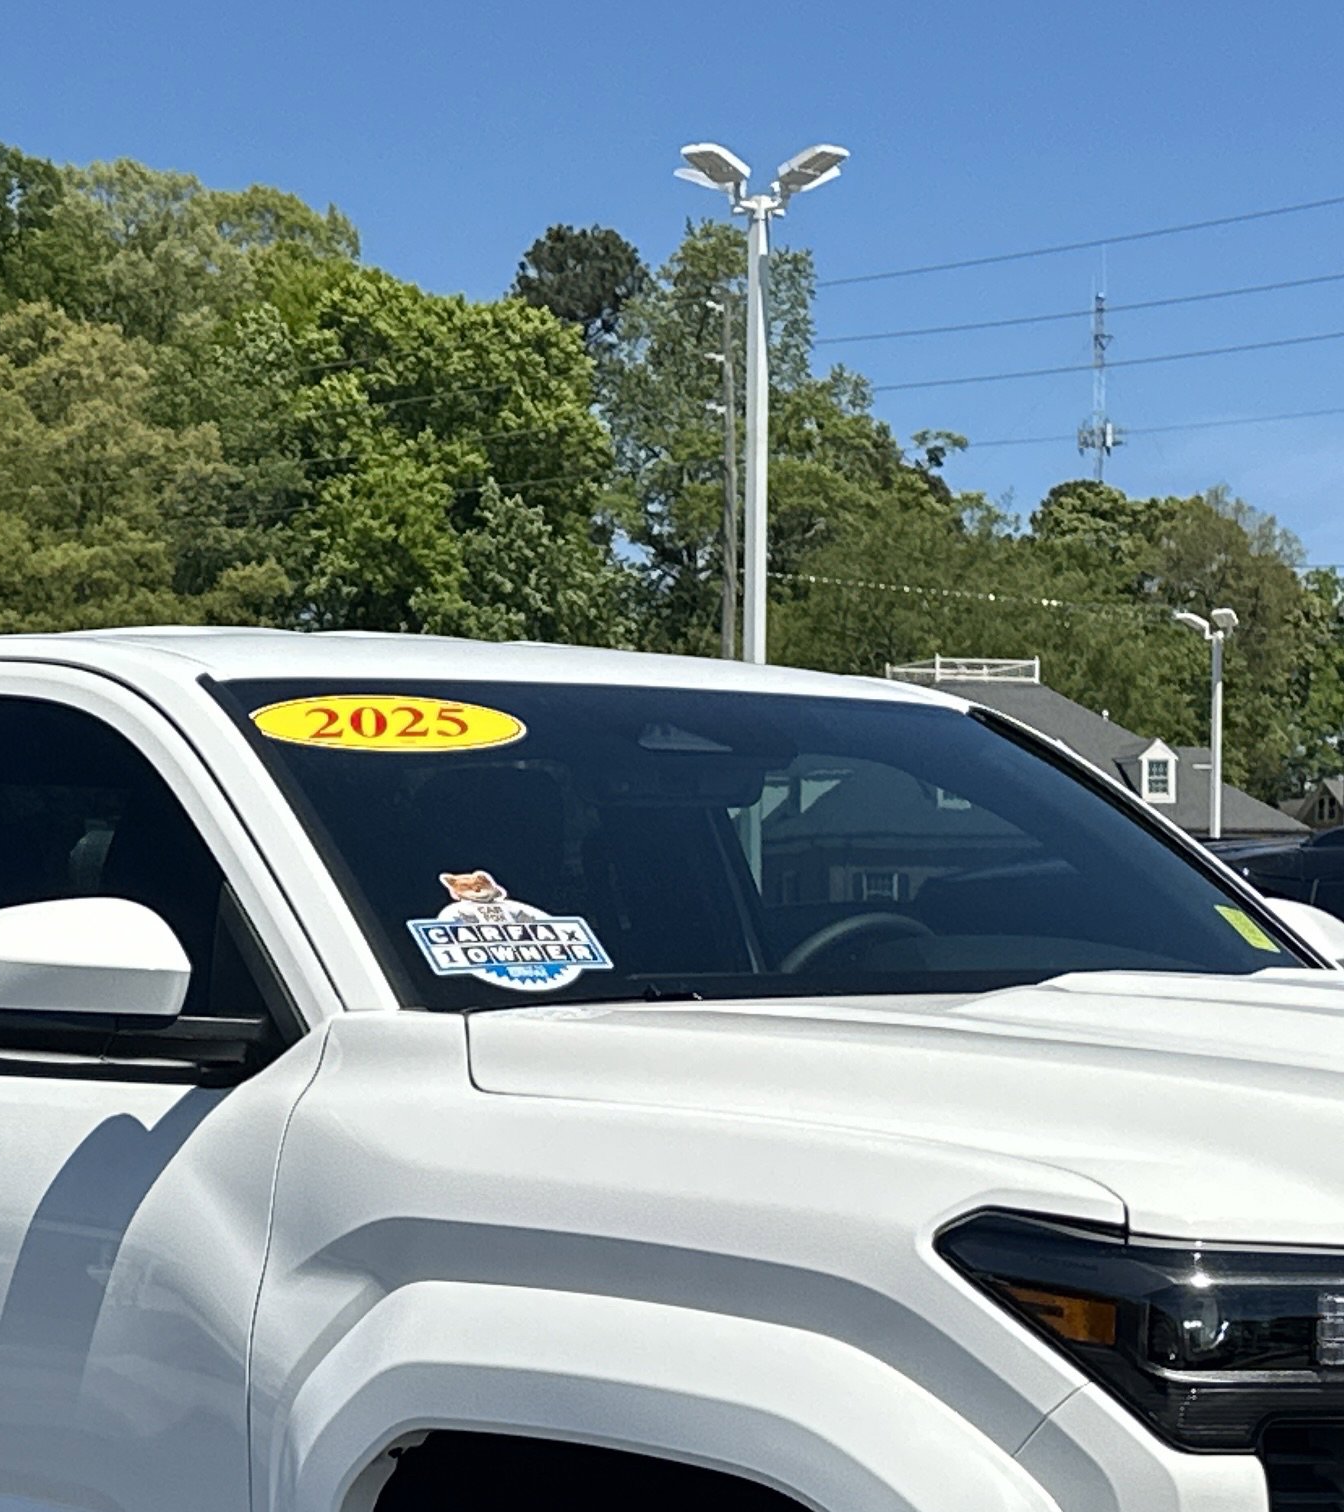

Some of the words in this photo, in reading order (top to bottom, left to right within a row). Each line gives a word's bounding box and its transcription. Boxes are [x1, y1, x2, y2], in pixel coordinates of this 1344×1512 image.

[305, 706, 469, 738] 2025
[426, 925, 582, 944] CARFAX
[442, 949, 458, 964] 1
[465, 944, 594, 964] OWNER
